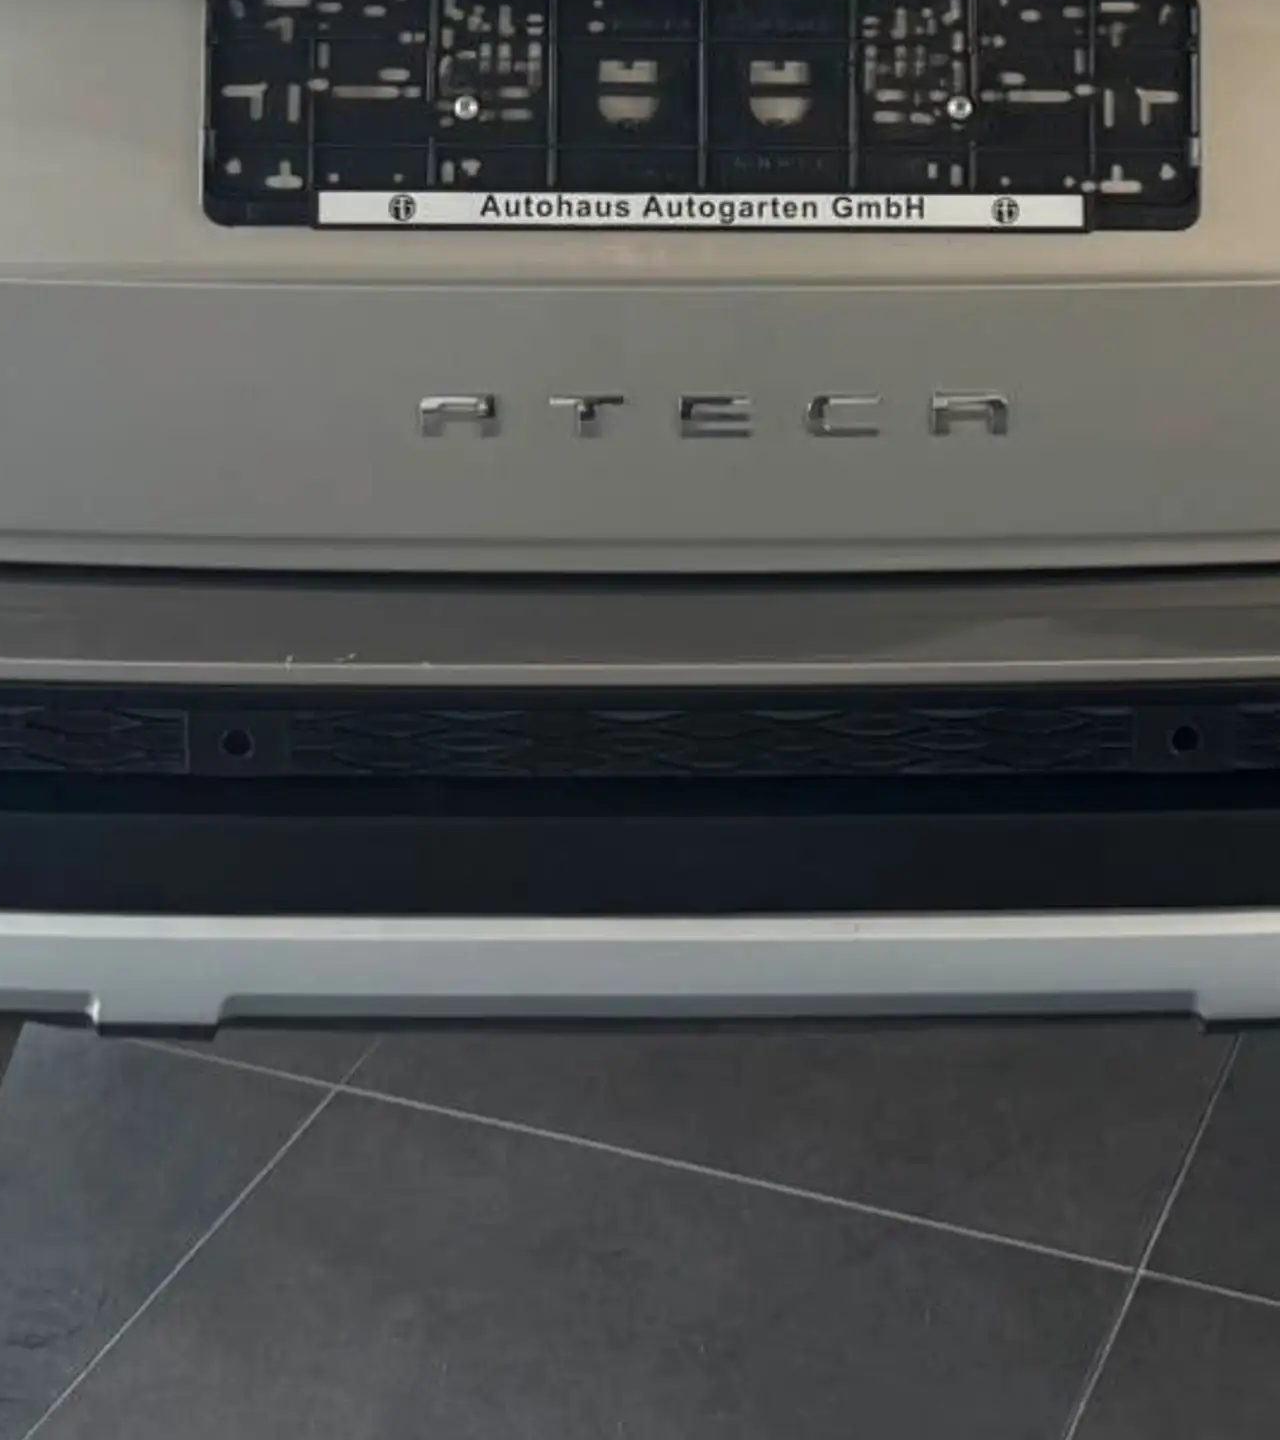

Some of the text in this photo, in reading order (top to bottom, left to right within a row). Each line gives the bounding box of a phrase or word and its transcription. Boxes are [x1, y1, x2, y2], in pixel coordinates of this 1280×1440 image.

[480, 195, 926, 224] Autohaus Autogarten GmbH
[418, 391, 1009, 438] ATECA
